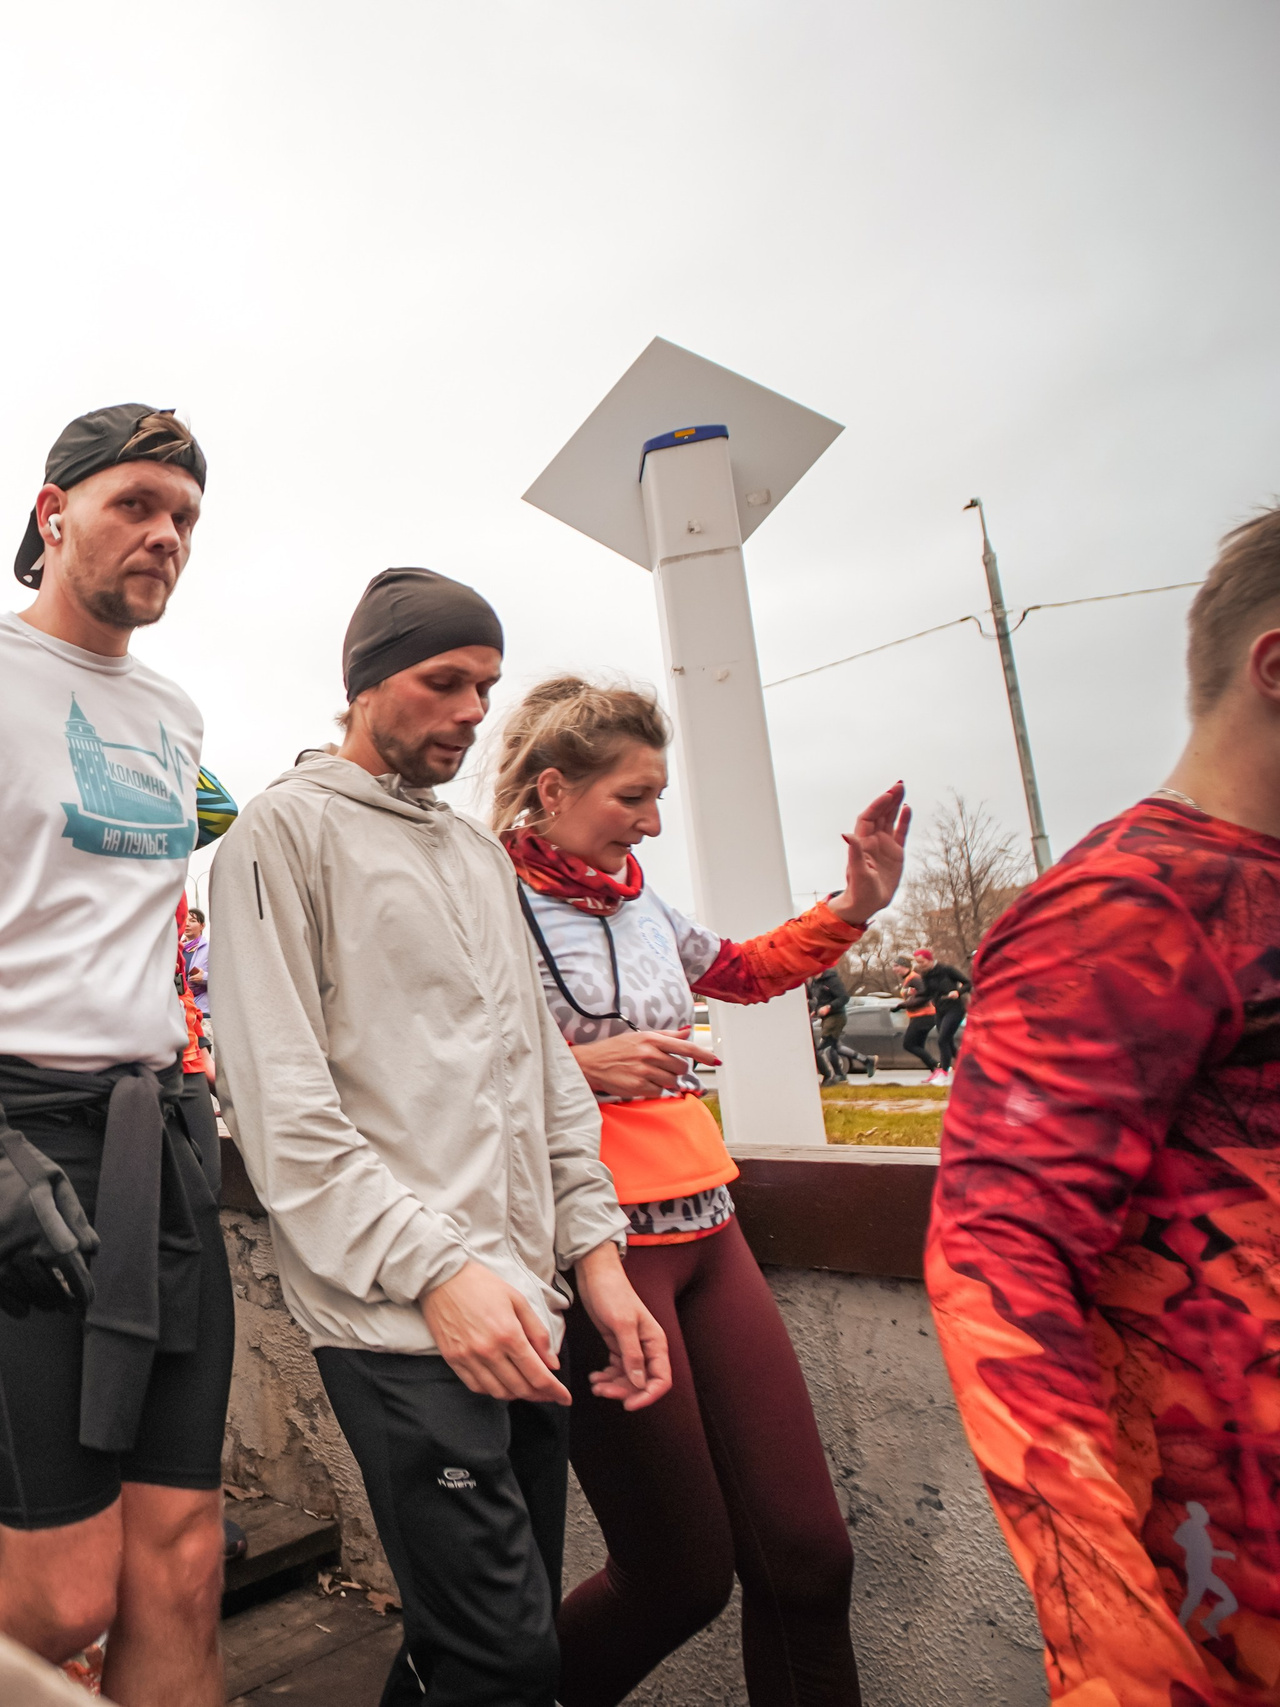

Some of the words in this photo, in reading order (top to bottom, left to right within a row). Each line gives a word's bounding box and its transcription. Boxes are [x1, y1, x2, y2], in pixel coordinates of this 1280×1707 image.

[108, 760, 168, 799] КОЛОМНА
[102, 827, 121, 852] НА
[122, 830, 169, 856] ПУЛЬСЕ
